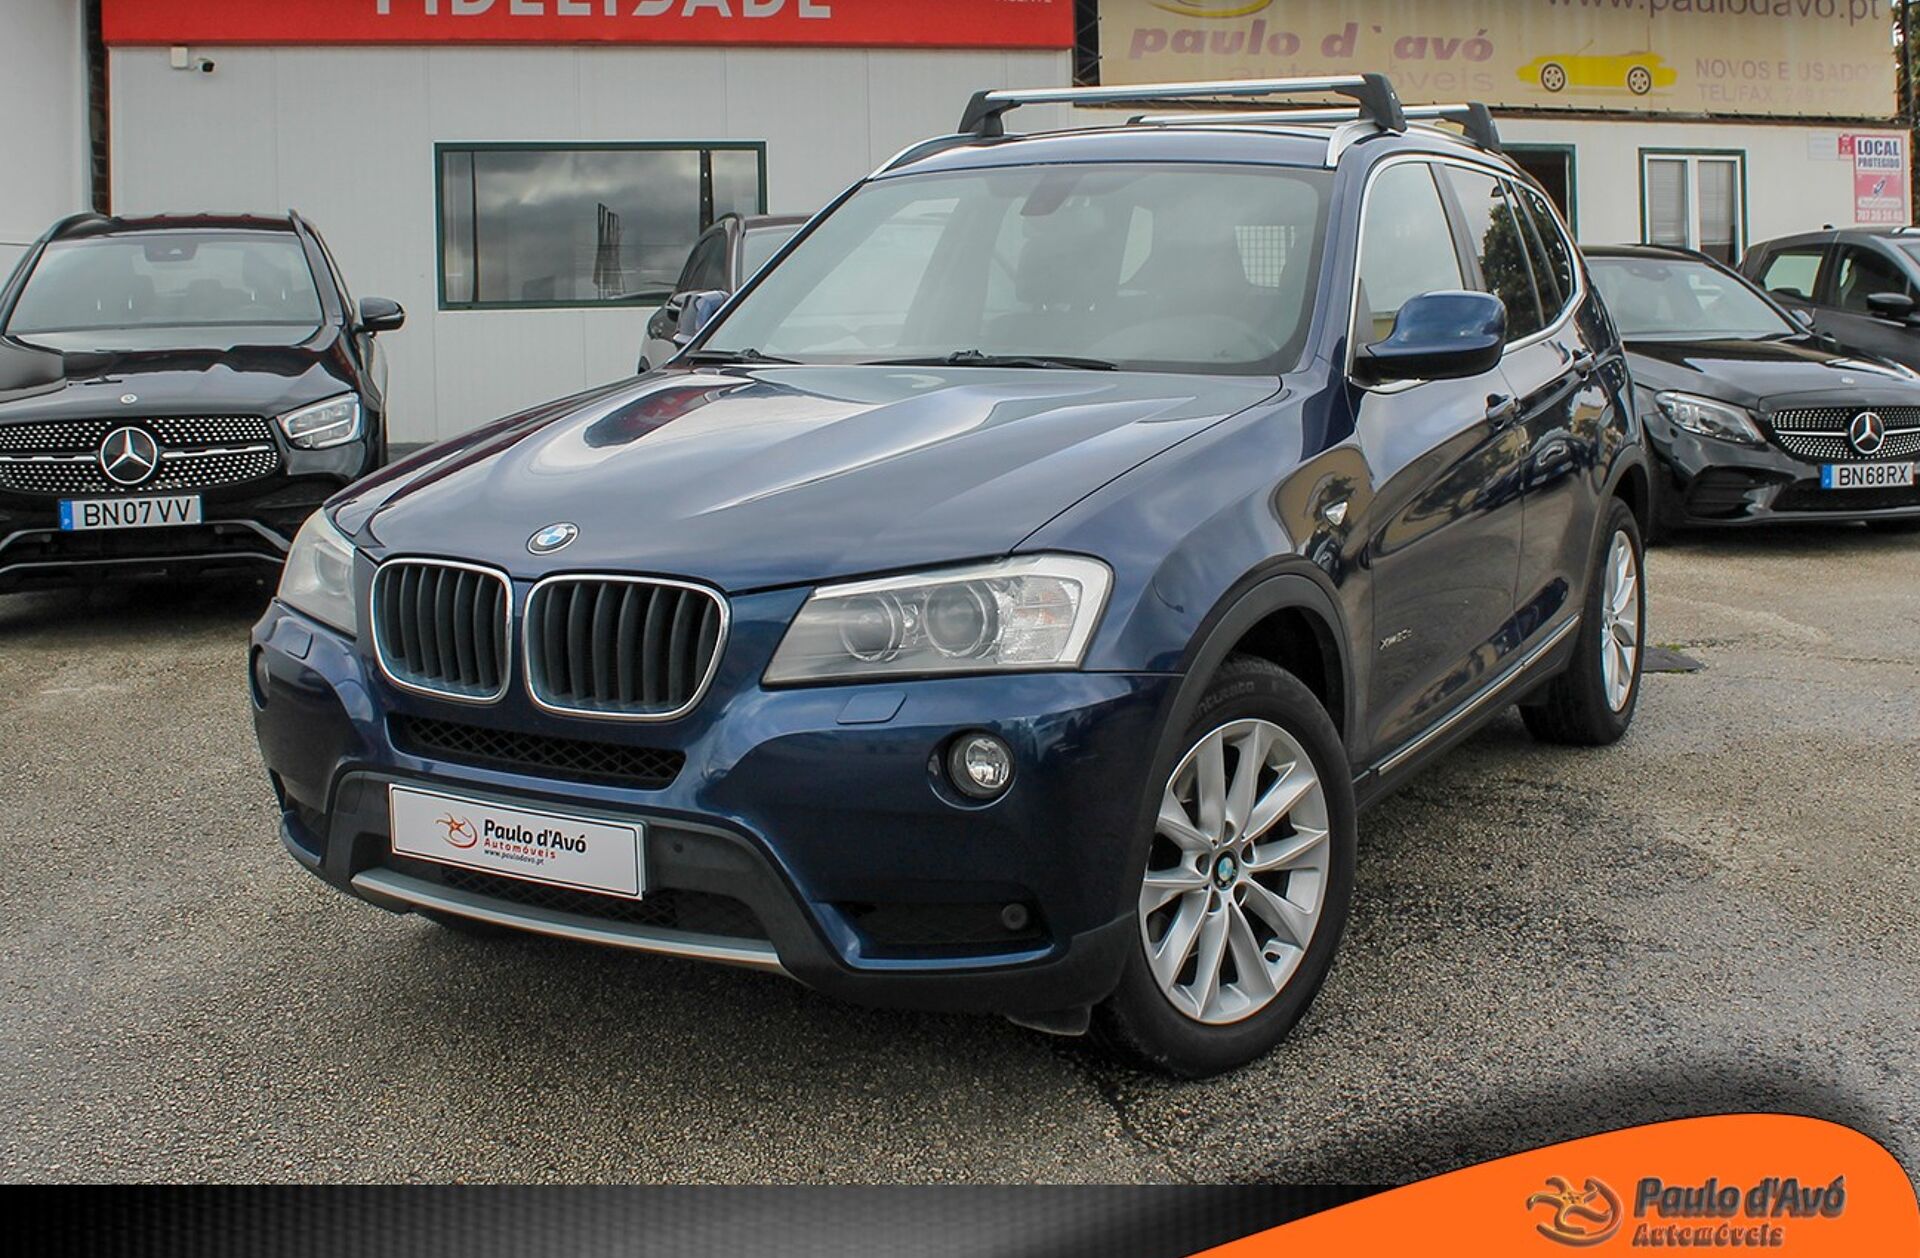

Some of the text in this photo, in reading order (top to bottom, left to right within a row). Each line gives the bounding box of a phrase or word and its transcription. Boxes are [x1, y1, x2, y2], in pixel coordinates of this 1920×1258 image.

[1128, 19, 1301, 60] paulo
[1695, 58, 1770, 80] NOVOS
[1777, 61, 1790, 81] E
[1857, 139, 1900, 156] LOCAL
[1857, 157, 1900, 169] PROTEGIDO
[1839, 465, 1908, 486] BN68RX
[83, 499, 191, 527] BN07VV
[484, 819, 587, 854] Paulo d'Avó
[484, 838, 557, 859] Automóveis
